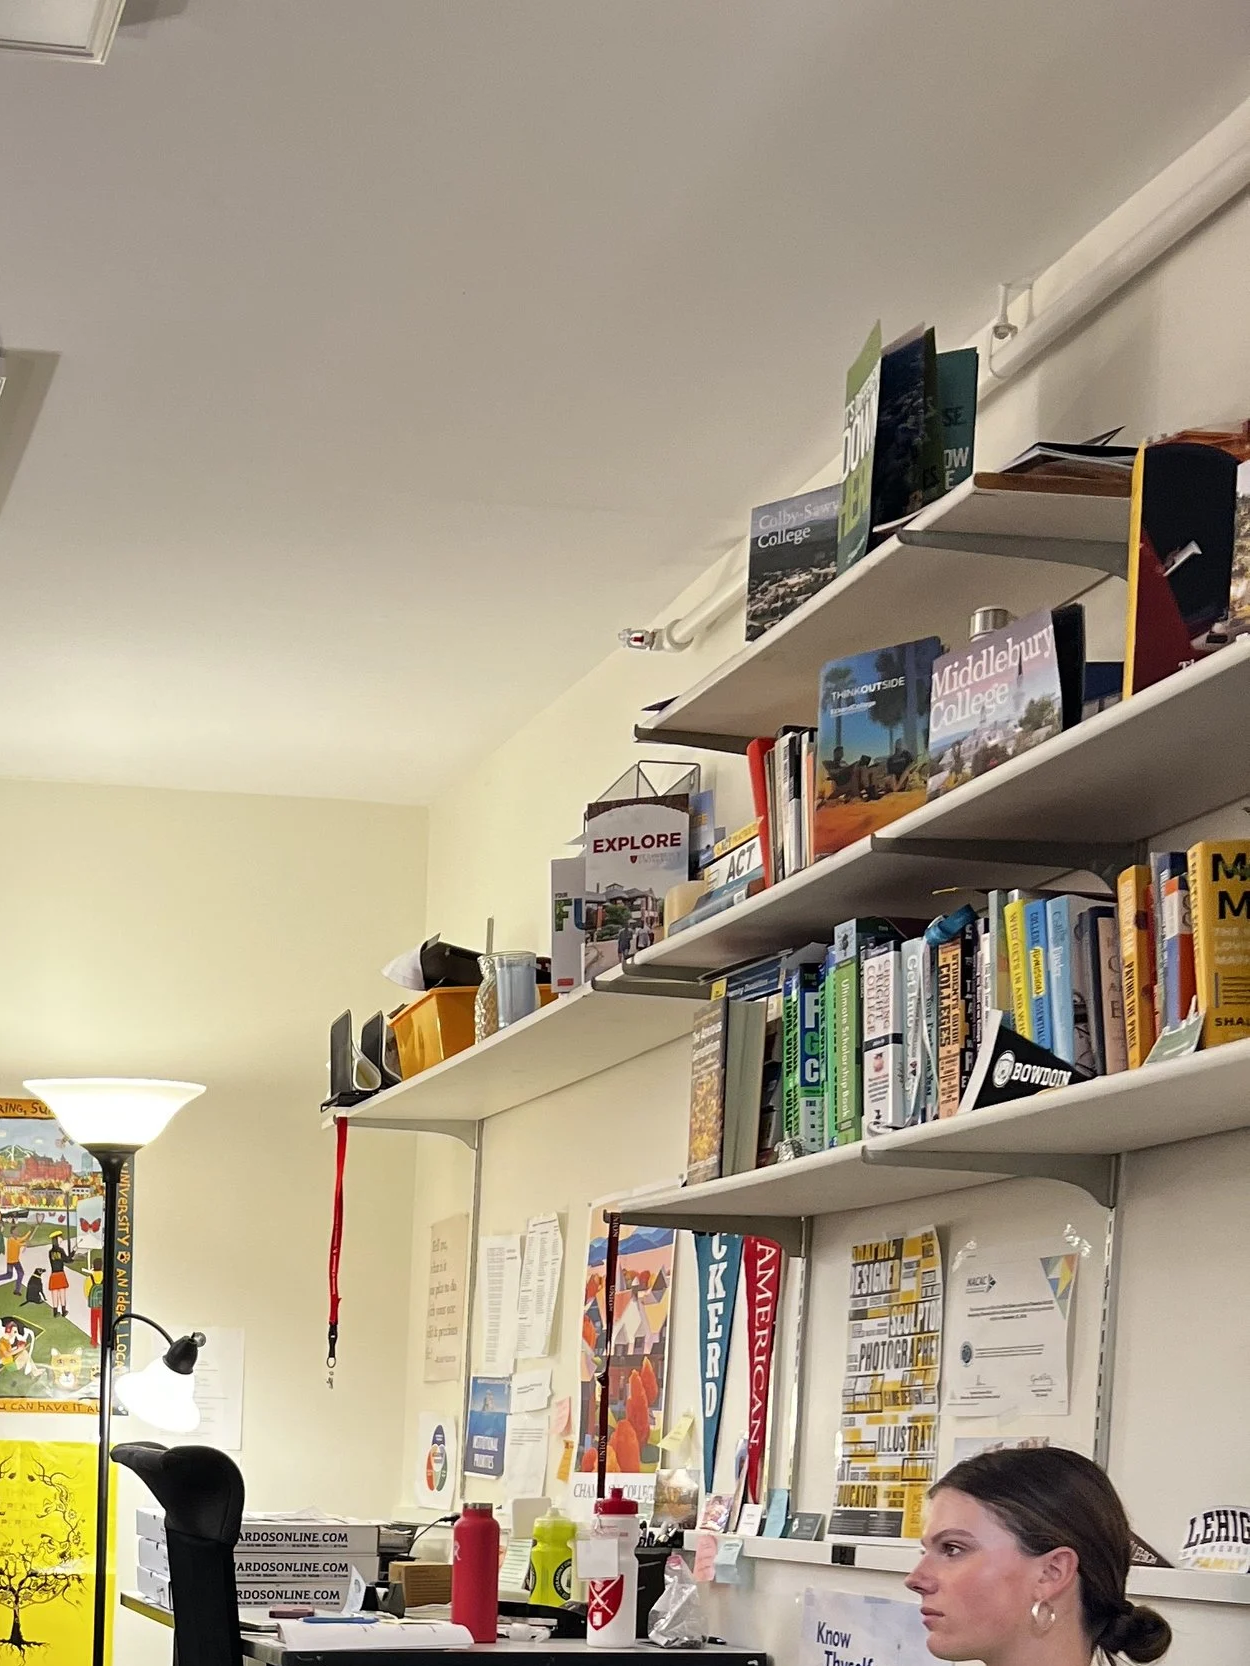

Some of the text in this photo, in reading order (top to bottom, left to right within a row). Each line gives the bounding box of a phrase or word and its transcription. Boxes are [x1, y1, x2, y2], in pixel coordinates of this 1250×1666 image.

[757, 525, 811, 549] College
[931, 624, 1054, 701] Middlebury
[930, 681, 1010, 731] College
[593, 832, 682, 854] EXPLORE
[726, 842, 756, 884] ACT
[867, 964, 876, 1035] COLLEGE
[876, 973, 884, 1021] RIGHT
[939, 963, 951, 1048] COLLEGES
[841, 978, 851, 1119] Ultimate Scholarship Book
[1011, 1062, 1073, 1087] BOWDOIN
[748, 1240, 779, 1449] AMERICAN
[87, 1404, 100, 1413] AL
[816, 1621, 851, 1648] Know
